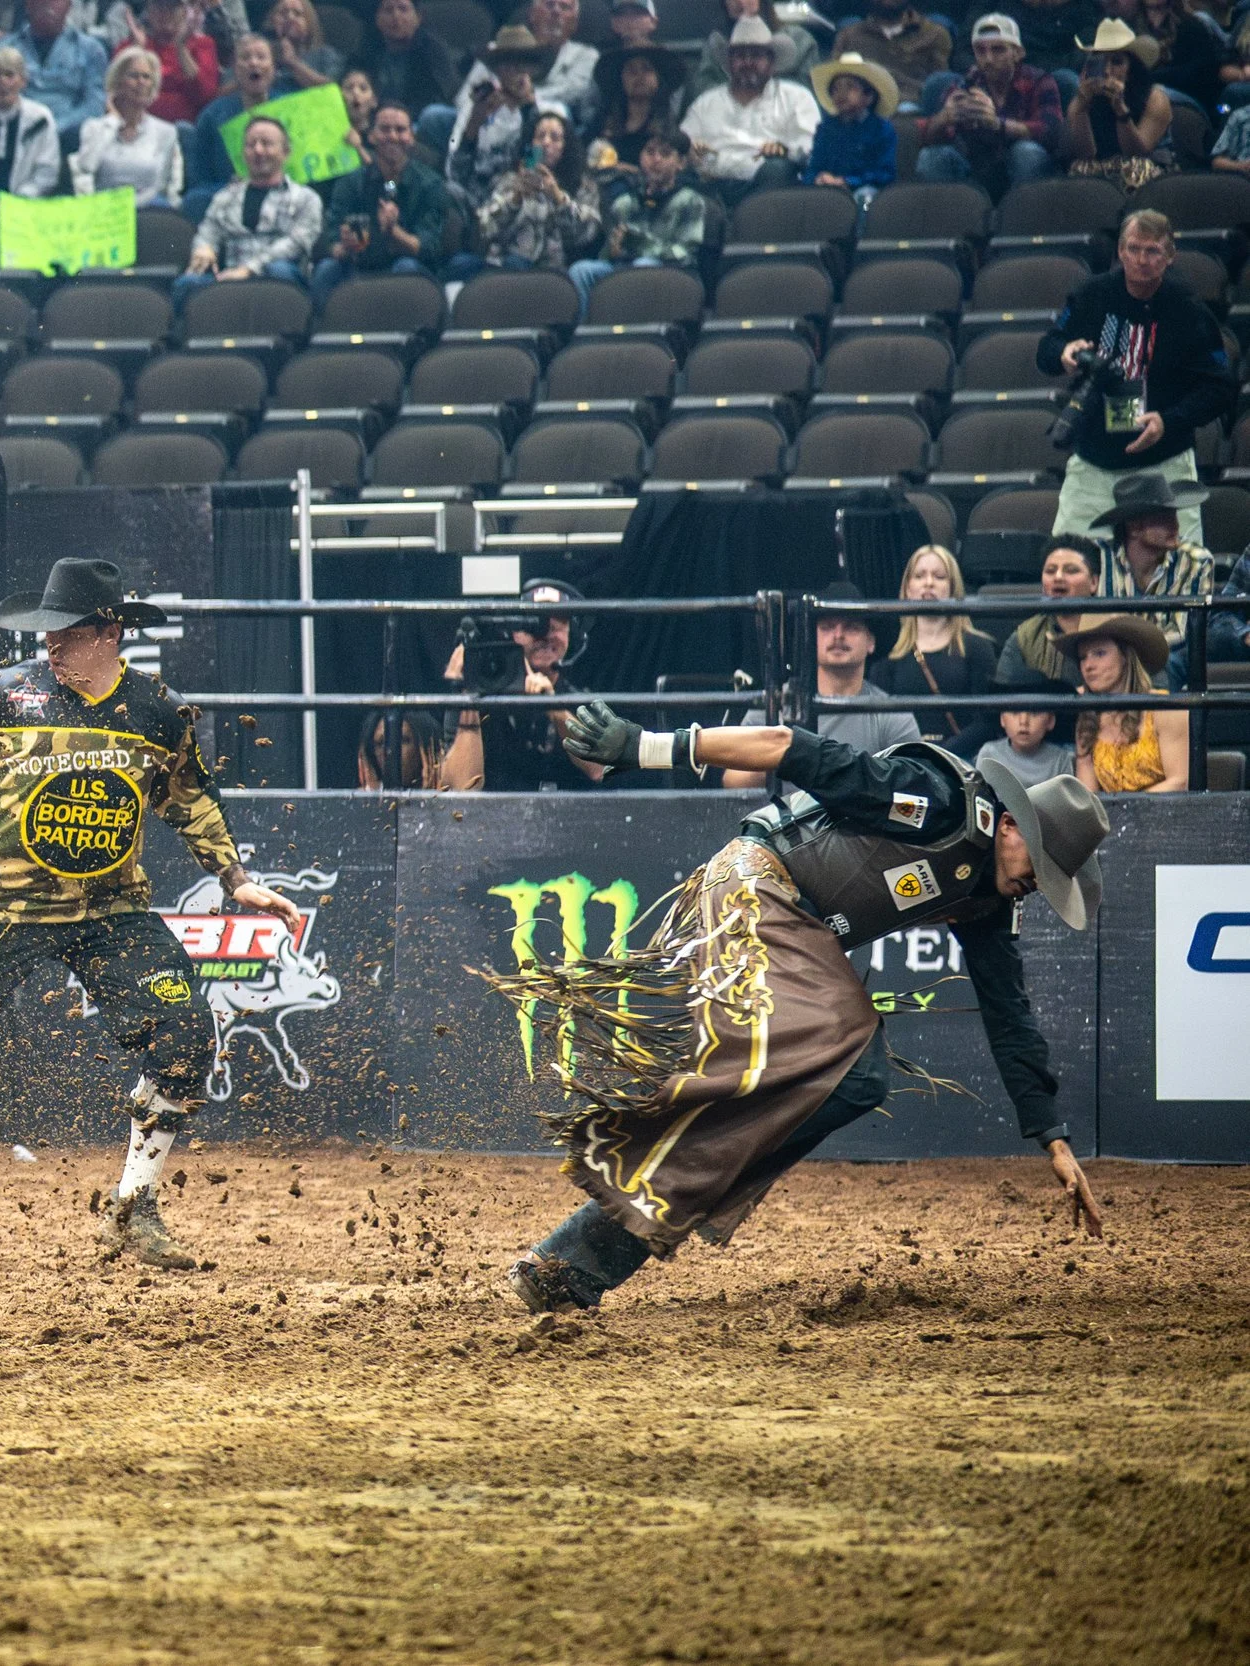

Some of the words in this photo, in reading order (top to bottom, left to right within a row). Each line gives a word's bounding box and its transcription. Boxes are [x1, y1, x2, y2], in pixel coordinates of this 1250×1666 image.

[70, 779, 109, 801] U.S.
[36, 803, 131, 827] BORDER
[913, 798, 925, 826] ARIAT
[34, 824, 123, 850] PATROL
[915, 863, 936, 896] ARIAT
[201, 963, 261, 977] BEAST
[871, 991, 936, 1014] GY
